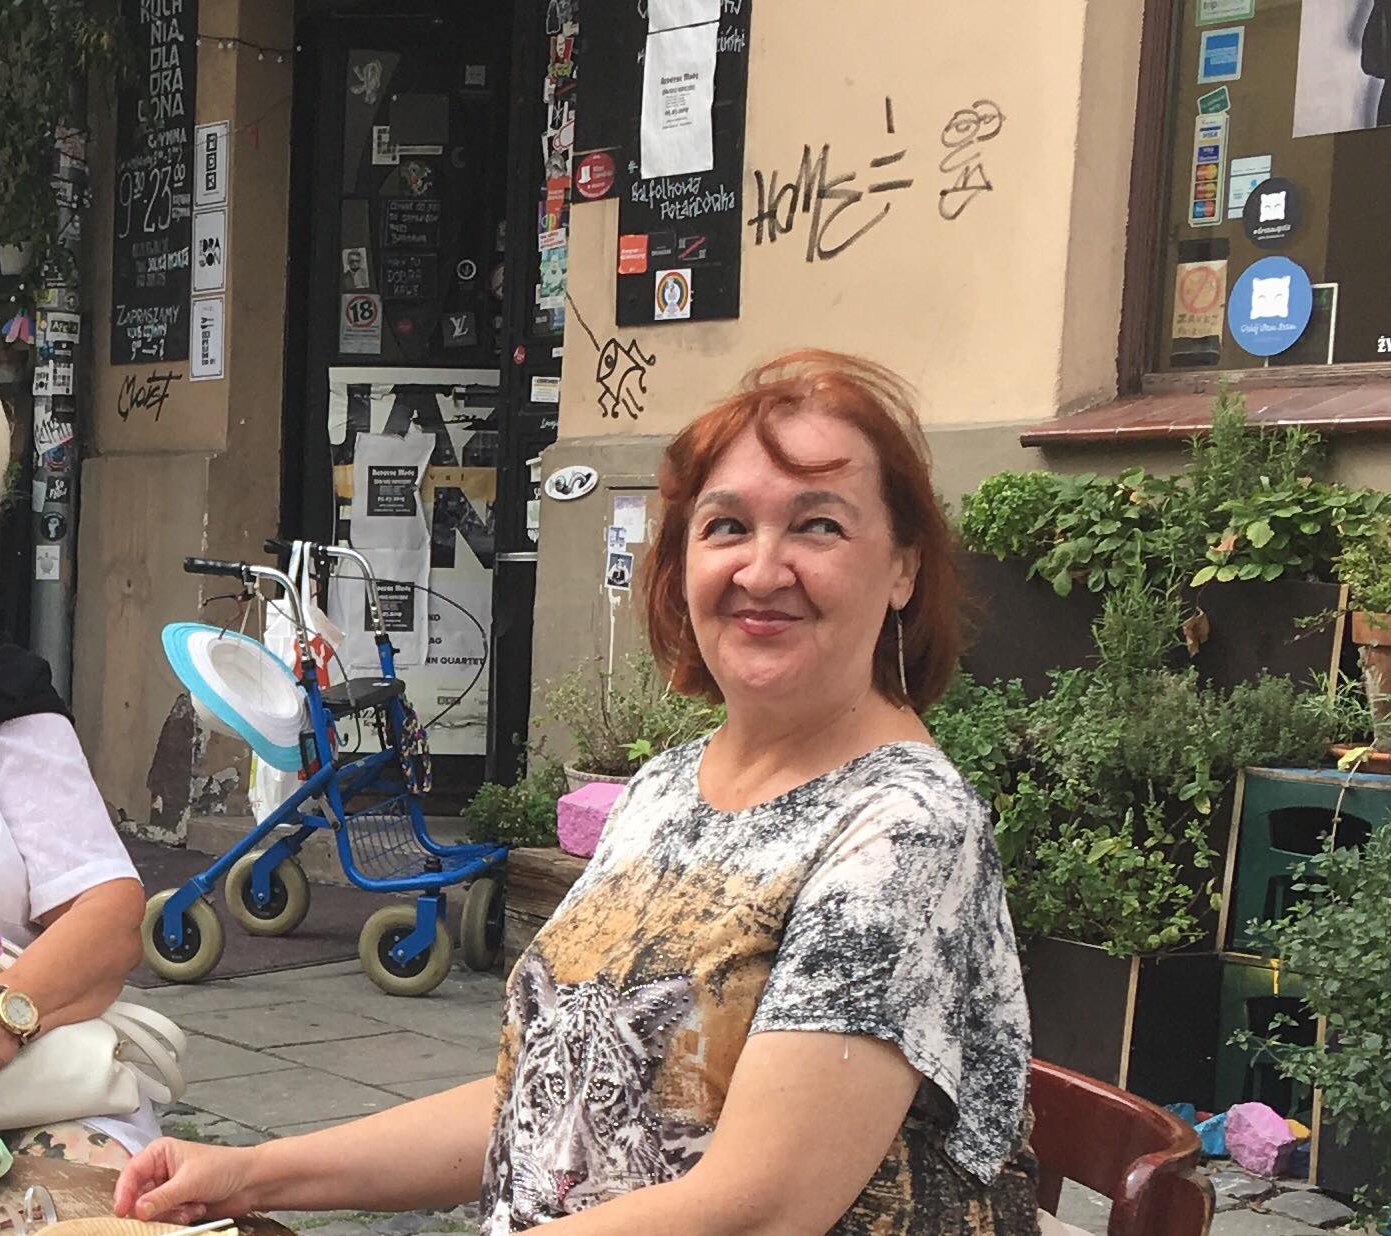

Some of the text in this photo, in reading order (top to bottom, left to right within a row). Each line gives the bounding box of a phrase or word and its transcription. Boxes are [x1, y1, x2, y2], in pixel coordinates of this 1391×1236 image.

[151, 18, 181, 45] NIA
[150, 44, 180, 71] DLA
[150, 67, 183, 96] DRA
[349, 300, 374, 323] 18
[440, 656, 485, 666] QUARTET
